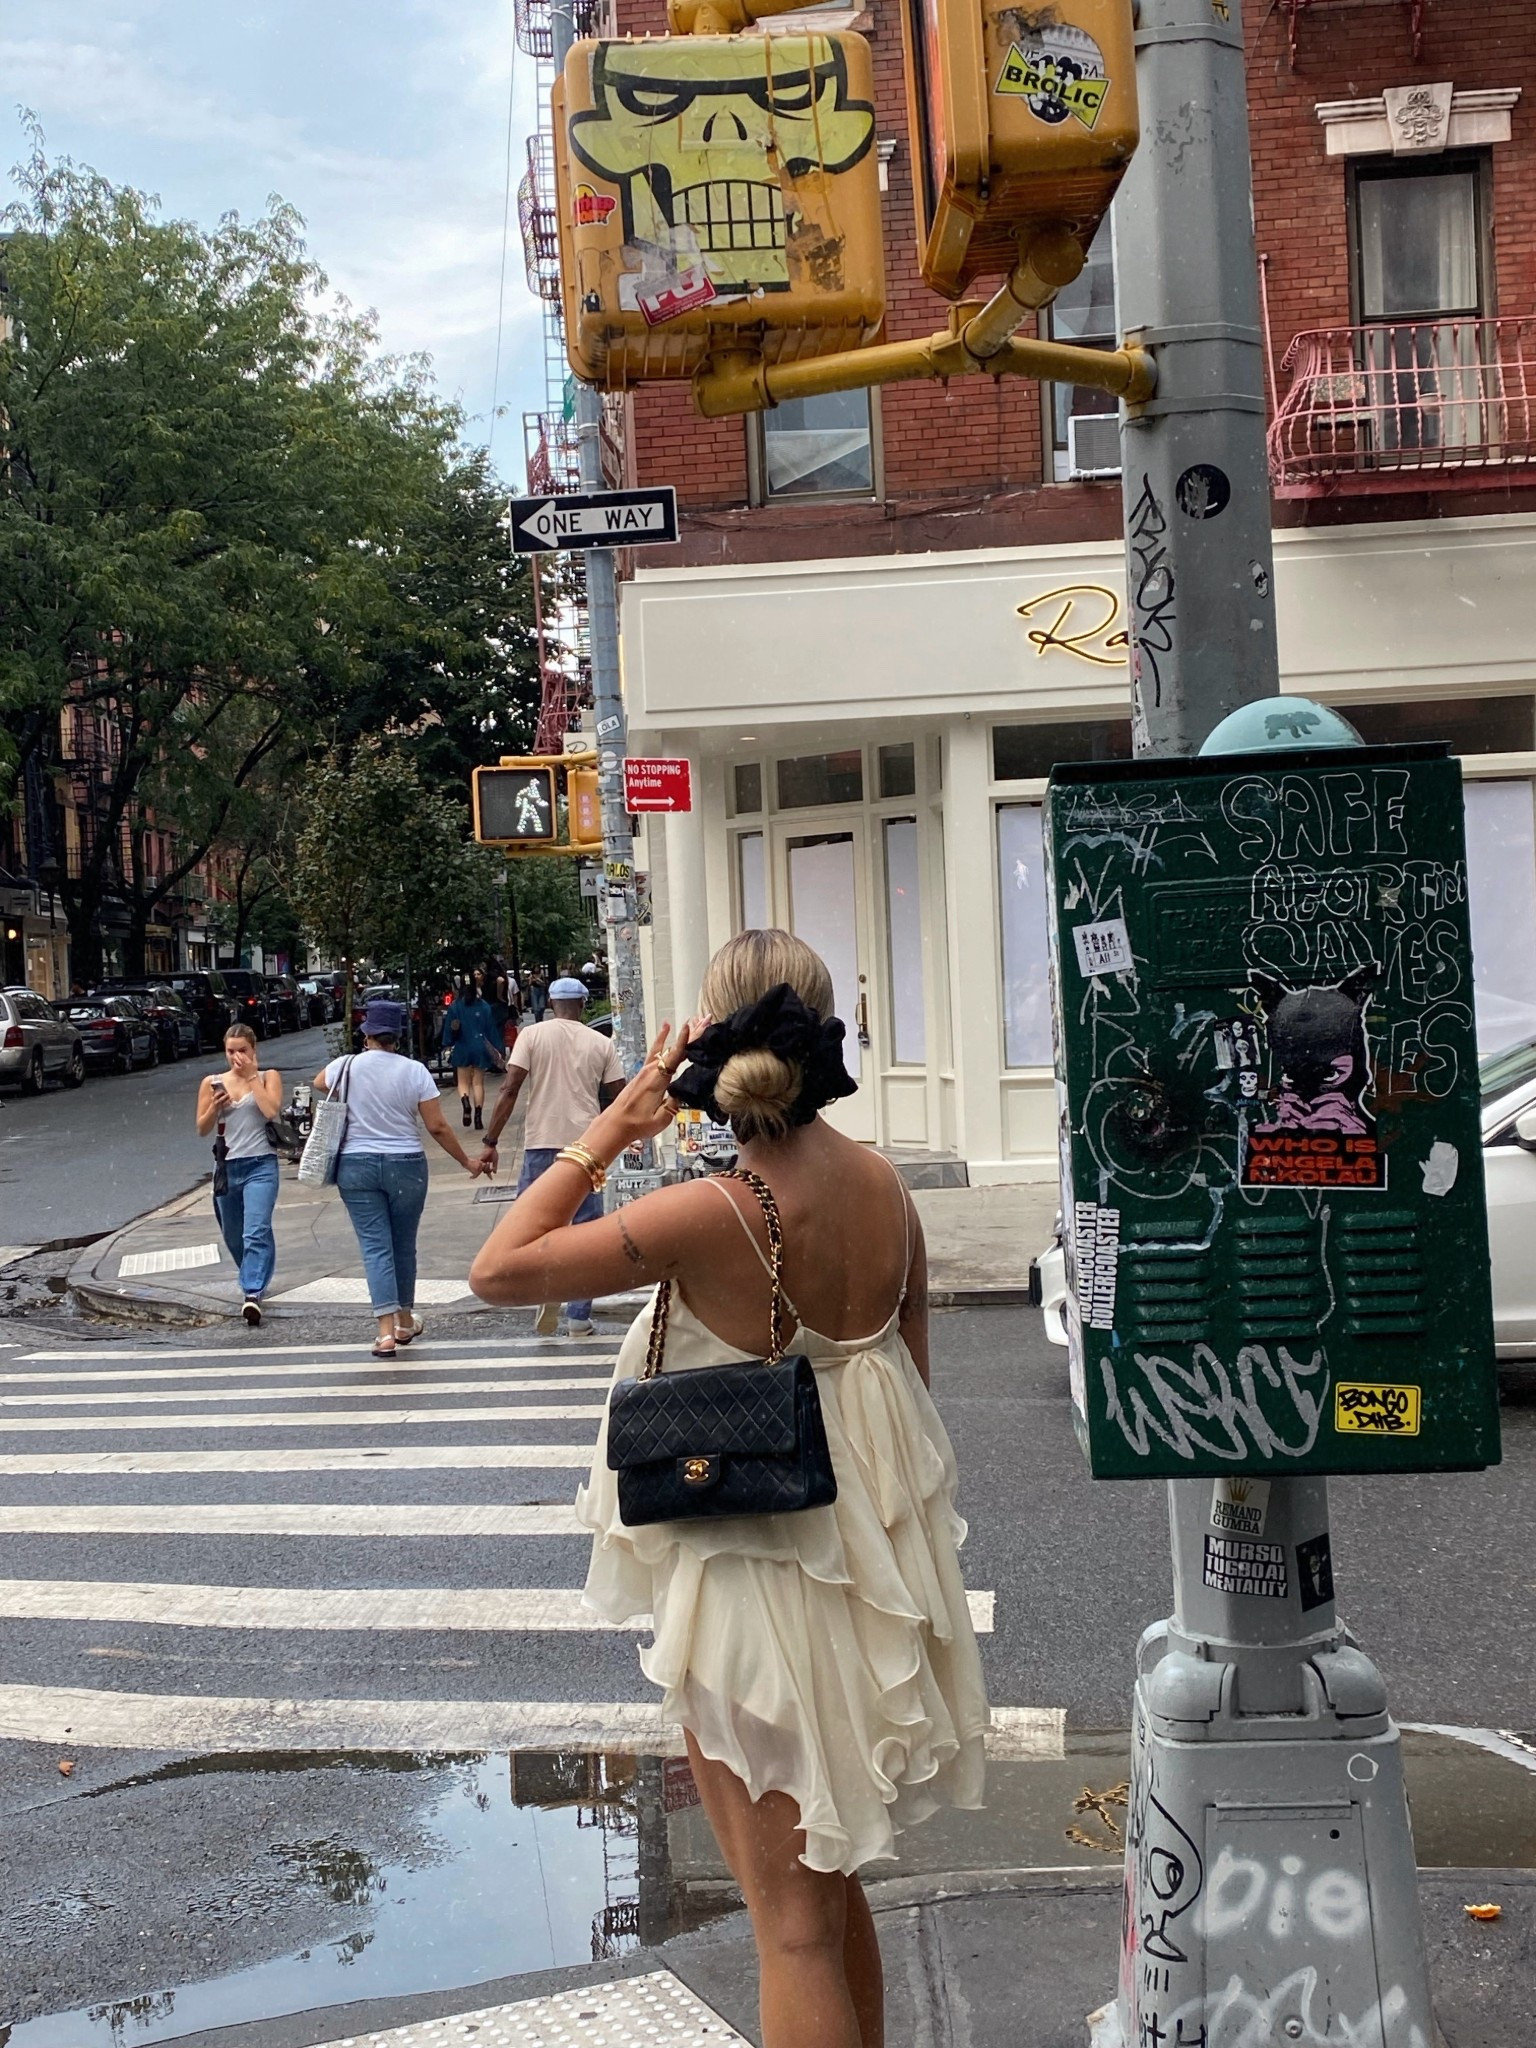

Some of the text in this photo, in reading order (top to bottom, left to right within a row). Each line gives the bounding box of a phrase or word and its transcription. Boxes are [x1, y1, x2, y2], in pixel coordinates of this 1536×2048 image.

[1005, 65, 1100, 108] BROLIC
[537, 507, 653, 535] ONE WAY
[627, 764, 681, 775] NO STOPPING
[629, 777, 662, 789] Anytime
[1220, 769, 1410, 863] SAFE
[1250, 1138, 1377, 1153] WHO IS
[1250, 1155, 1377, 1169] ANGELA
[1090, 1208, 1120, 1330] ROLLERCOASTER
[1339, 1389, 1408, 1415] BONGO
[1215, 1500, 1262, 1521] REMAND
[1213, 1514, 1260, 1534] GUMBA
[1205, 1553, 1286, 1580] TUGBOAT
